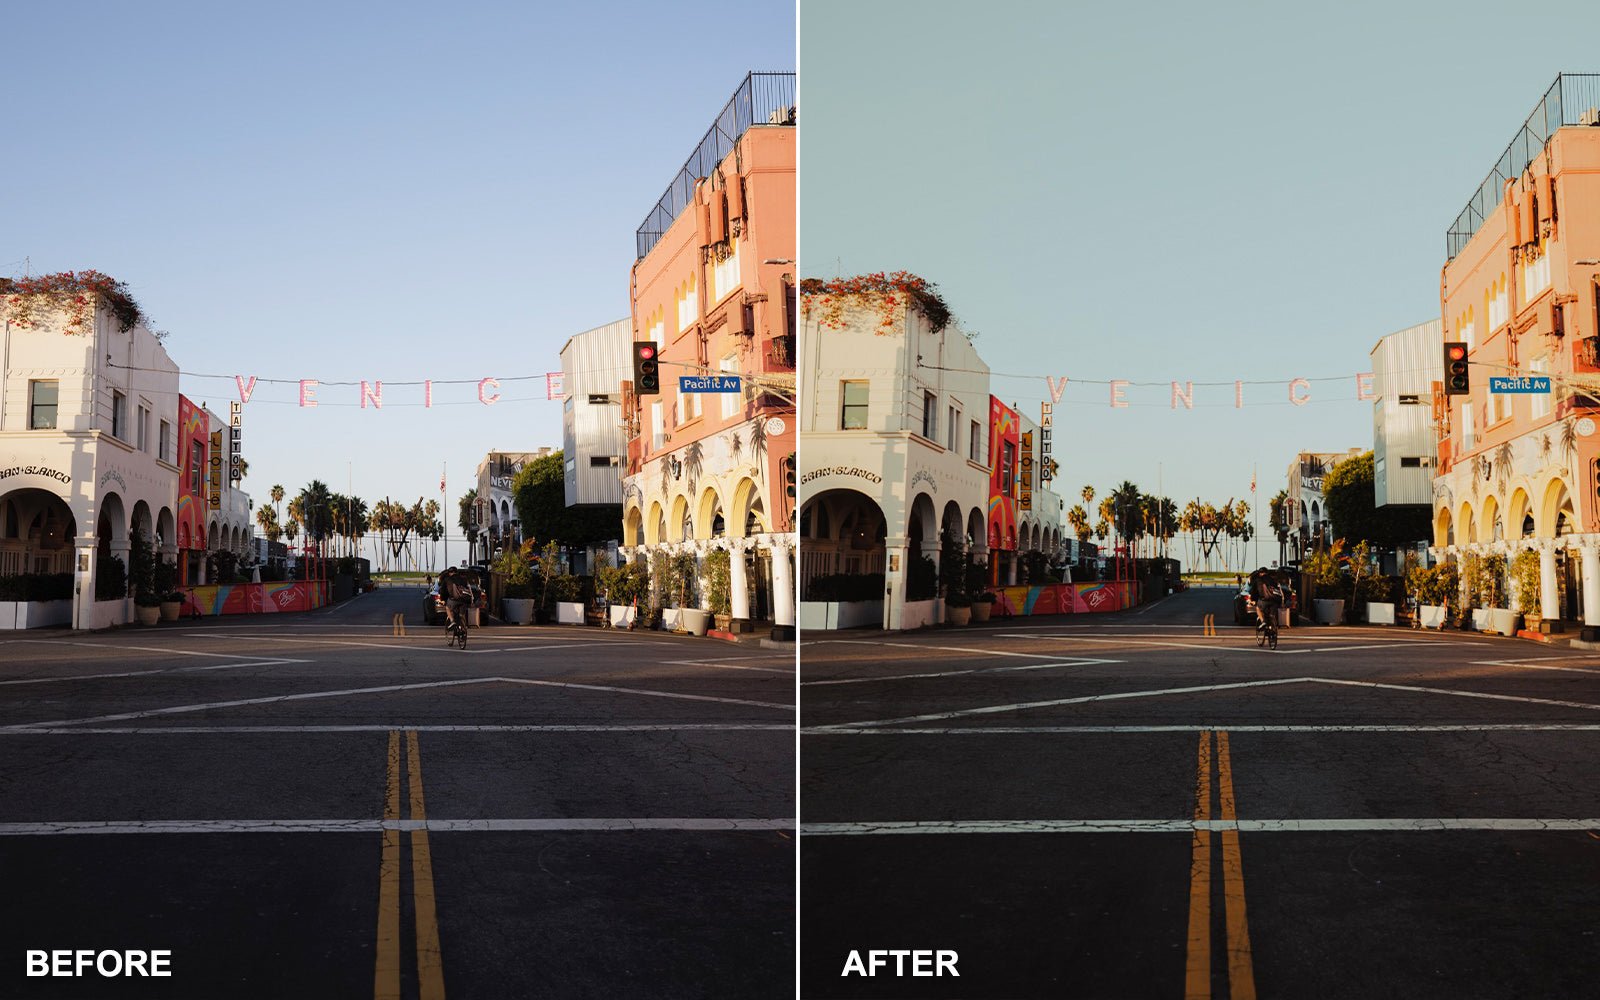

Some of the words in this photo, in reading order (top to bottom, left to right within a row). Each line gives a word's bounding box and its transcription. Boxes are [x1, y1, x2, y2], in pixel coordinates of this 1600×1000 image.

[236, 372, 567, 408] VENICE
[684, 379, 720, 389] Pacific
[724, 379, 737, 388] Av
[1046, 372, 1377, 409] VENICE
[1494, 380, 1531, 389] Pacific
[1534, 380, 1547, 389] Av
[1043, 404, 1051, 478] TATTOO
